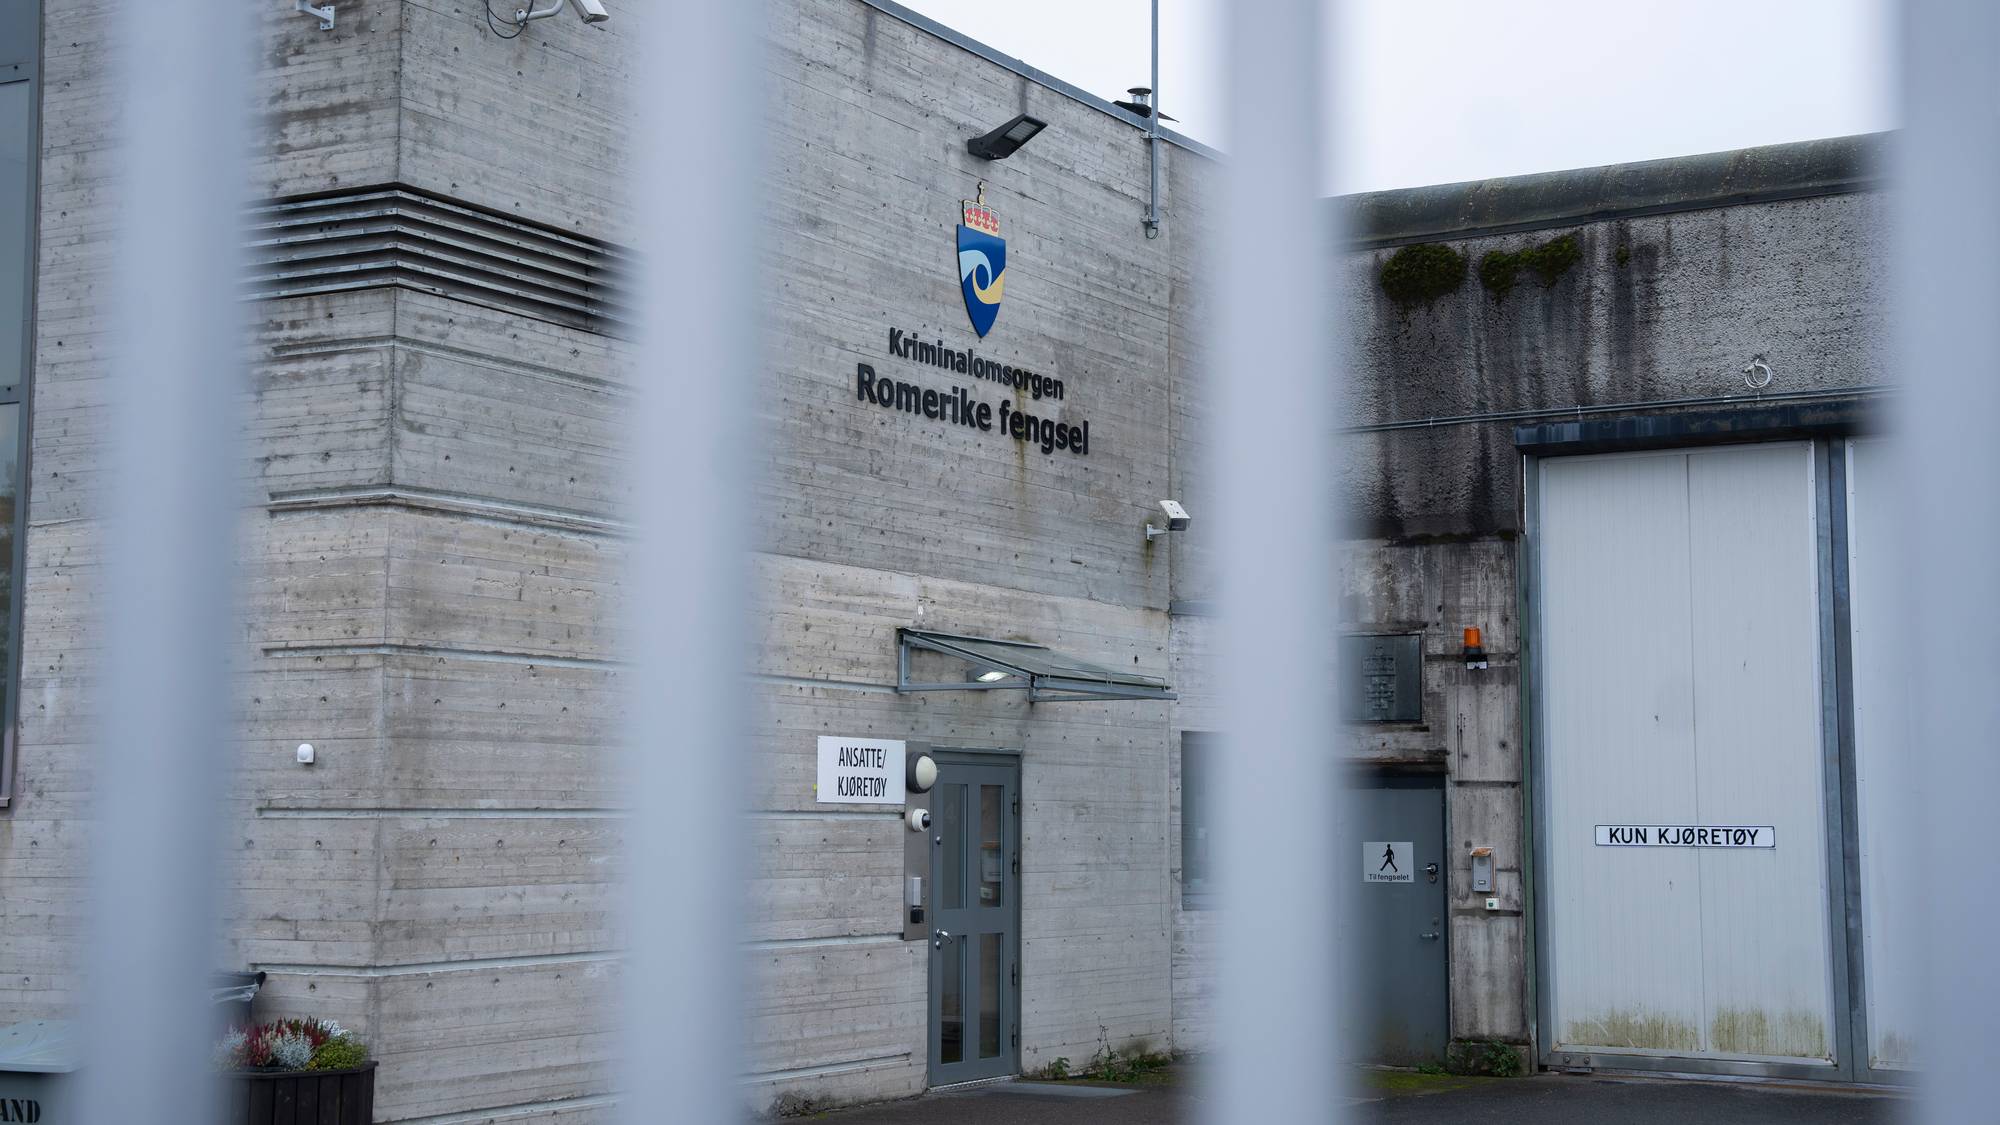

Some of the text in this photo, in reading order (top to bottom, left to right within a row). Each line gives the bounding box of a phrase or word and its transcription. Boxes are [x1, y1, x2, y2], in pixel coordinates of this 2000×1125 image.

[889, 327, 1064, 400] Kriminalomsorgen
[857, 362, 1089, 455] Romerike fengsel
[838, 746, 887, 769] ANSATTE/
[837, 775, 887, 798] KJØRETØY
[1609, 827, 1759, 845] KUN KJØRETØY
[1377, 873, 1410, 881] fengselet
